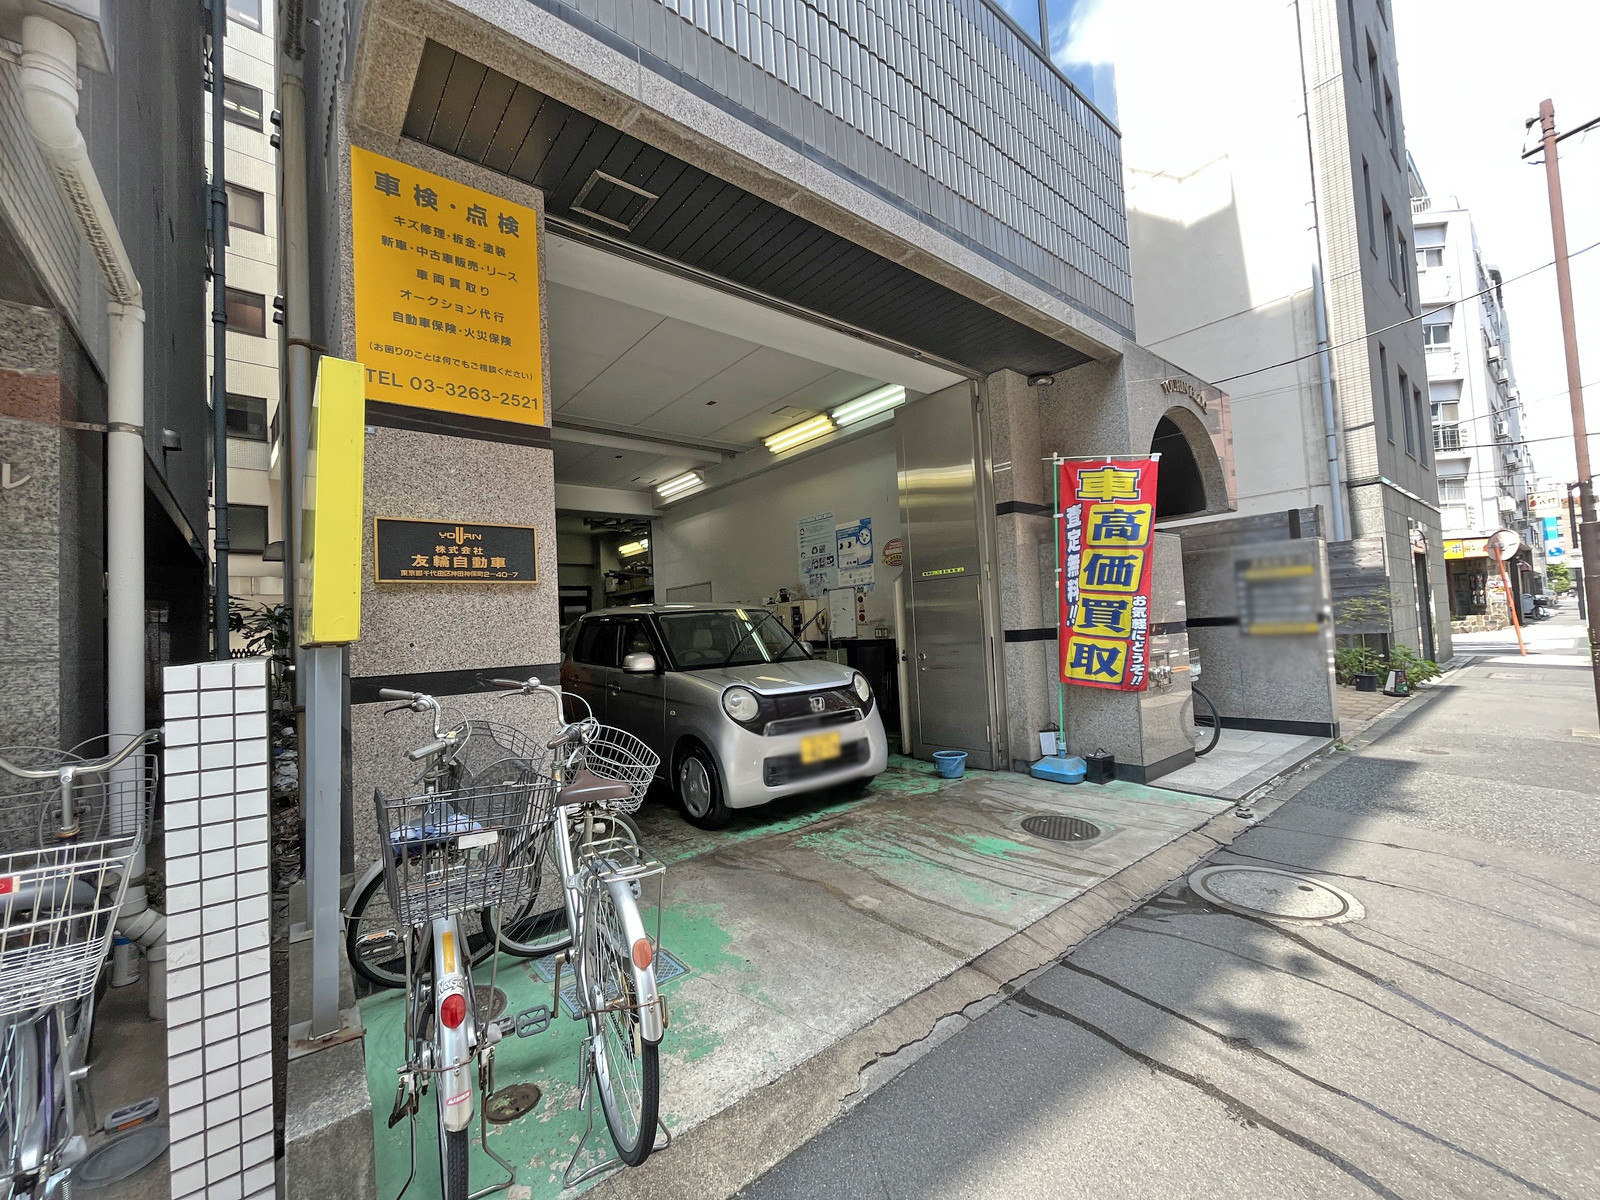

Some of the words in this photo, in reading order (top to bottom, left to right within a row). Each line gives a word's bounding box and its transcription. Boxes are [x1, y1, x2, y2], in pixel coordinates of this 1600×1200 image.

[374, 171, 519, 238] 車検・点検
[394, 216, 506, 258] キズ修理・板金・塗装
[381, 235, 518, 283] 新車・中古車販売・リース
[416, 269, 490, 297] 車両買取り
[400, 289, 505, 323] オークション代行
[392, 311, 512, 347] 自動車保険・火災保険
[365, 368, 403, 388] TEL
[410, 376, 538, 410] 03-3263-2521
[411, 553, 507, 569] 友輪自動車
[435, 545, 484, 556] 株式会社
[1130, 596, 1148, 685] お気軽にどうぞ!!
